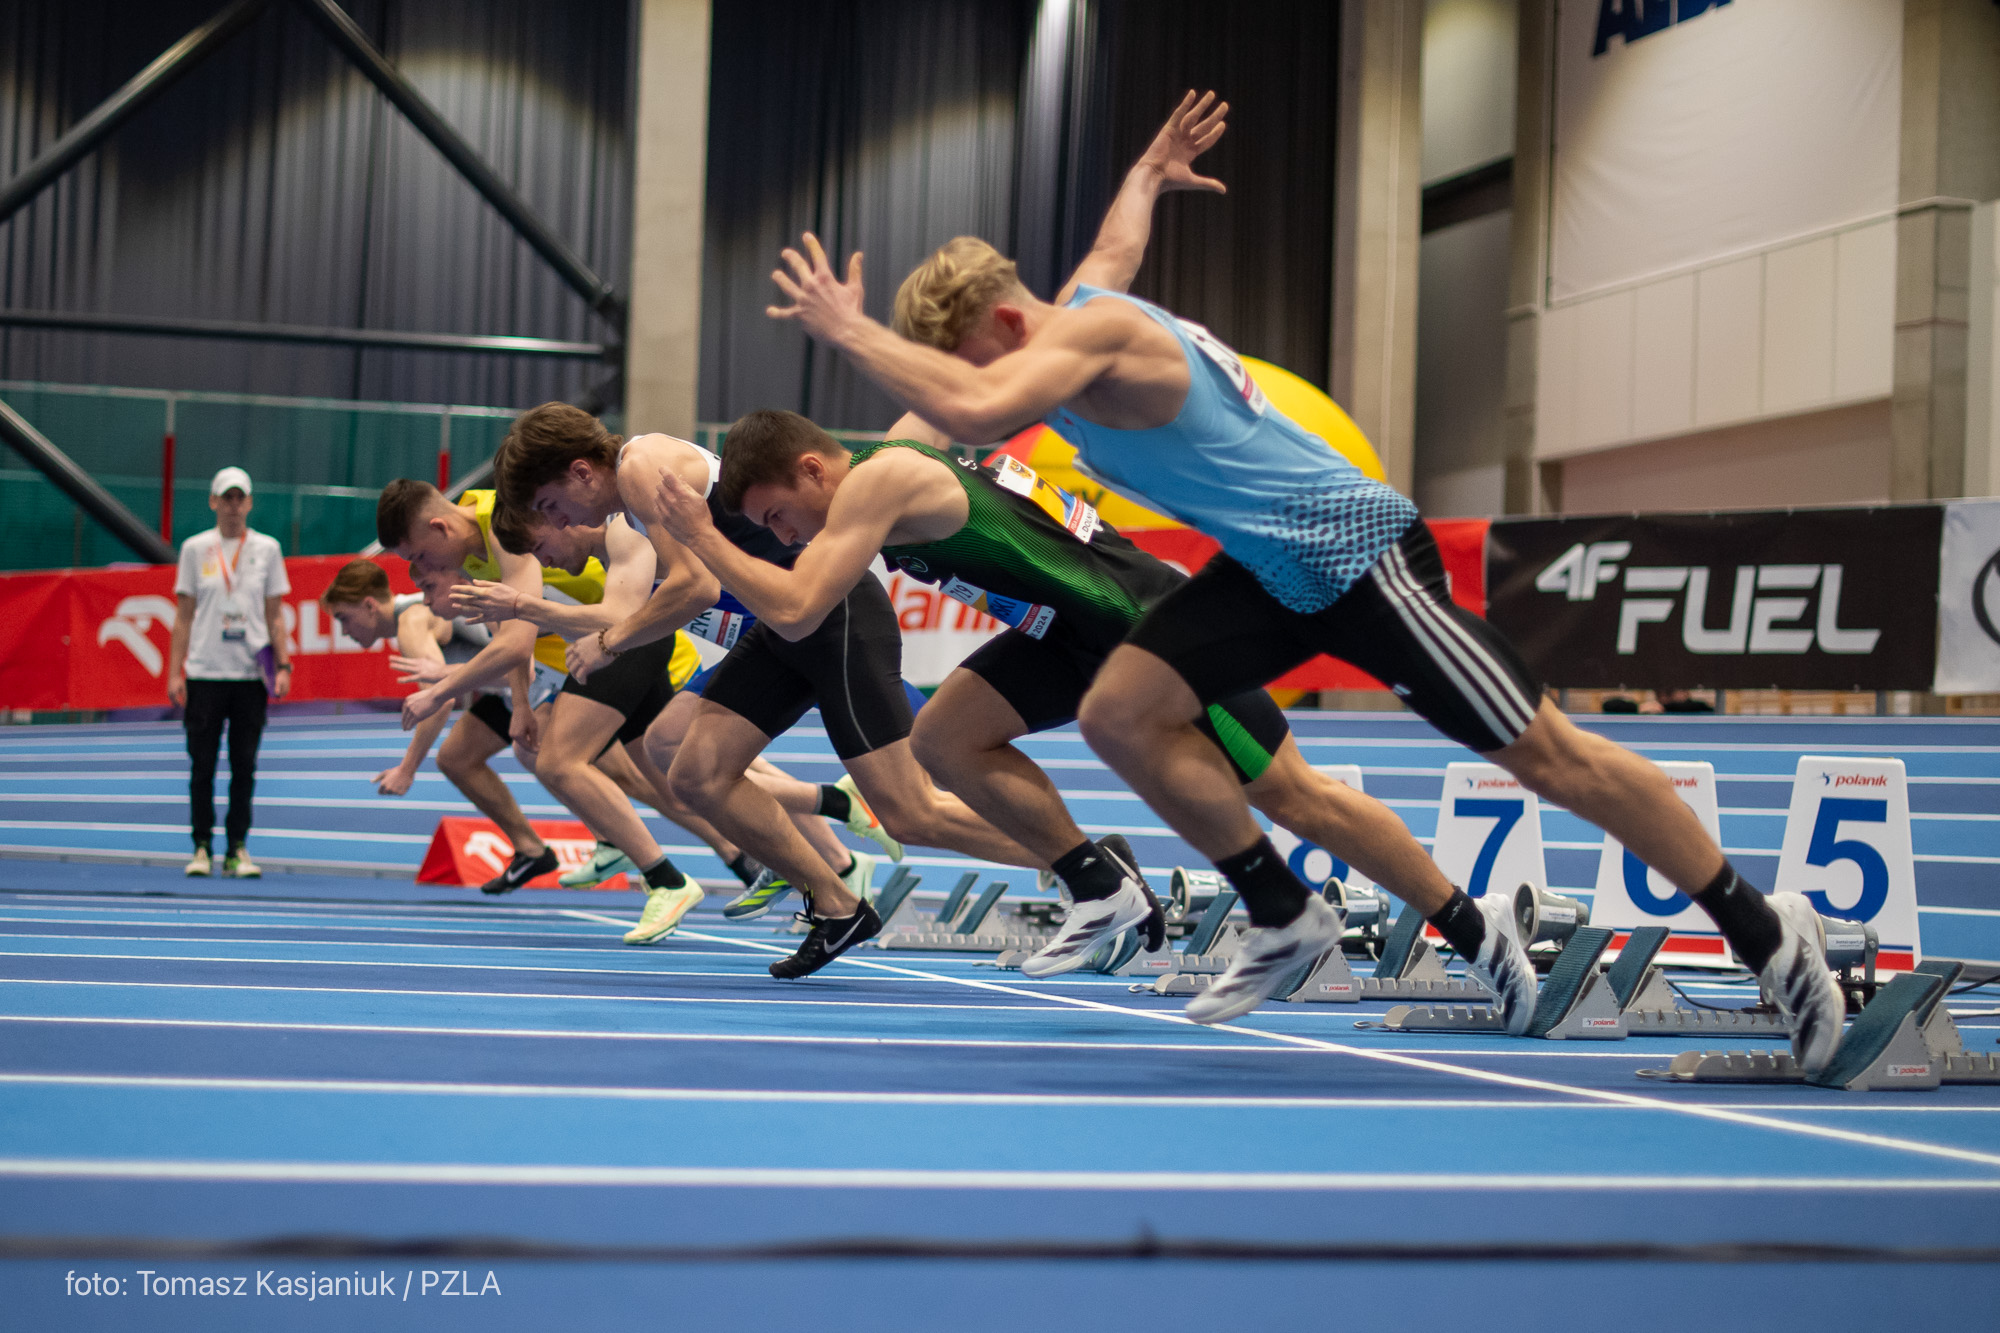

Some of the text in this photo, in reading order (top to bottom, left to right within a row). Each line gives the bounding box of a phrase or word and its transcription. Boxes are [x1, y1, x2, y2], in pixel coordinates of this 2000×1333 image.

[1535, 541, 1882, 654] 4F FUEL
[1835, 774, 1888, 788] polanik
[1454, 798, 1524, 897] 7
[1801, 797, 1890, 924] 5
[1593, 1019, 1617, 1027] polanik
